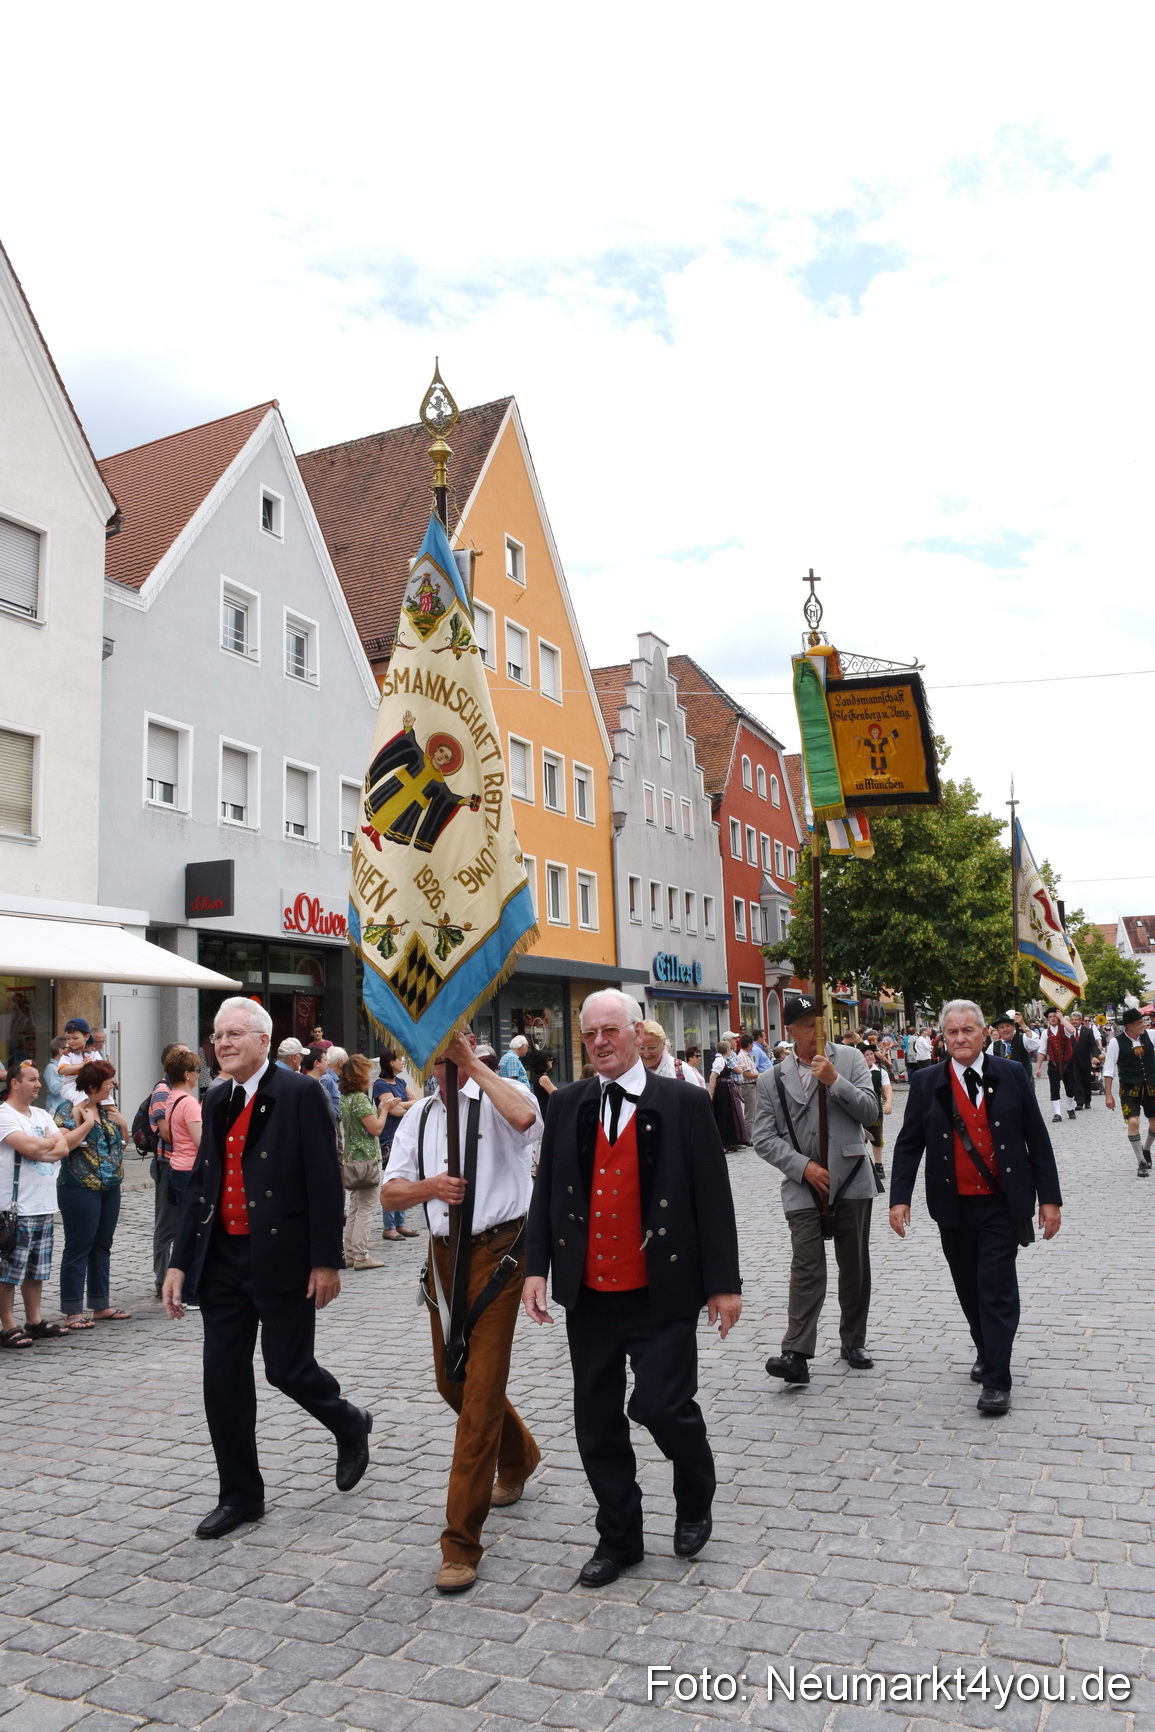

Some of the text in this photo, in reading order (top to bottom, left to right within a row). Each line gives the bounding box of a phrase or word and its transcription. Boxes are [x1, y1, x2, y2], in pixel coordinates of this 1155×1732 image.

[855, 777, 904, 790] in München
[191, 895, 225, 911] s.Oliver
[283, 892, 348, 937] s.Oliver
[654, 951, 693, 983] Eilles
